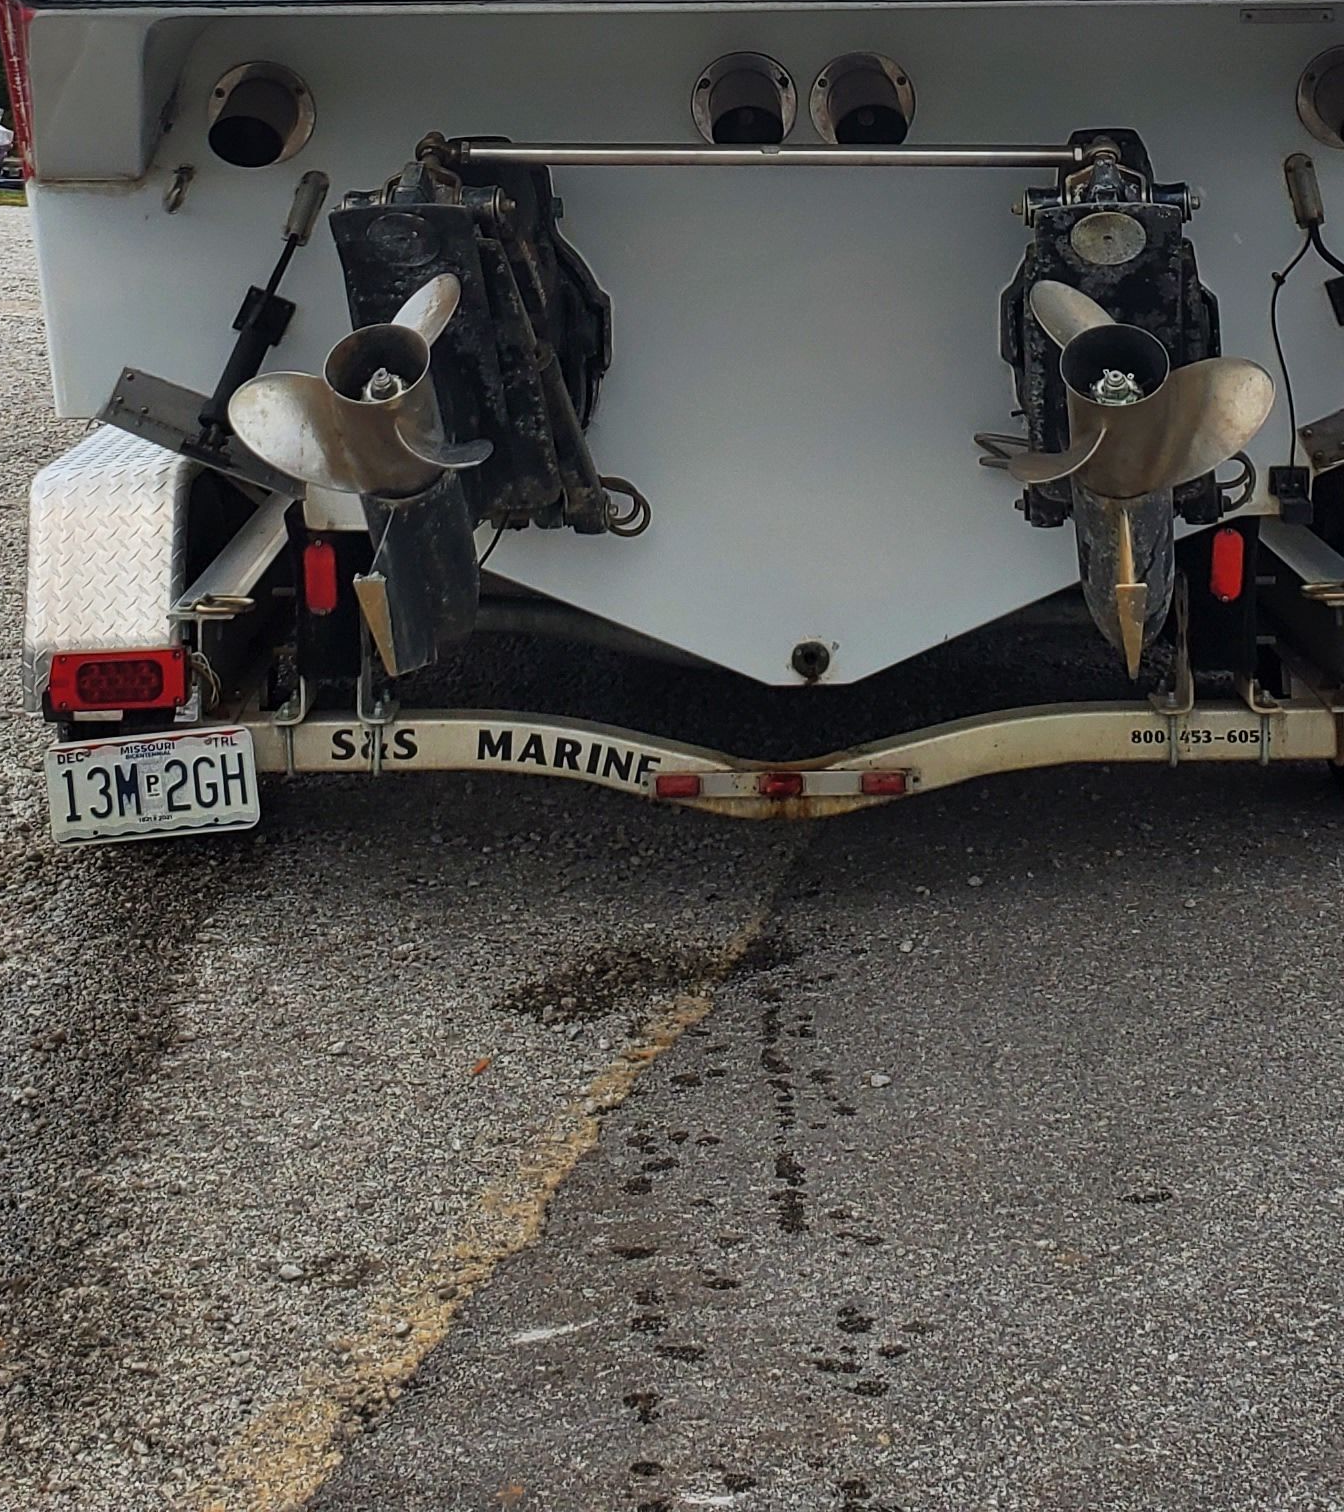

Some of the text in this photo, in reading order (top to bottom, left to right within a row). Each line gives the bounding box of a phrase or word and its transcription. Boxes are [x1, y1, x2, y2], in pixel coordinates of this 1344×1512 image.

[120, 741, 176, 756] MISSOURI
[213, 736, 239, 749] TRL
[57, 751, 85, 766] DEC
[125, 750, 172, 760] BICENTENNIAL
